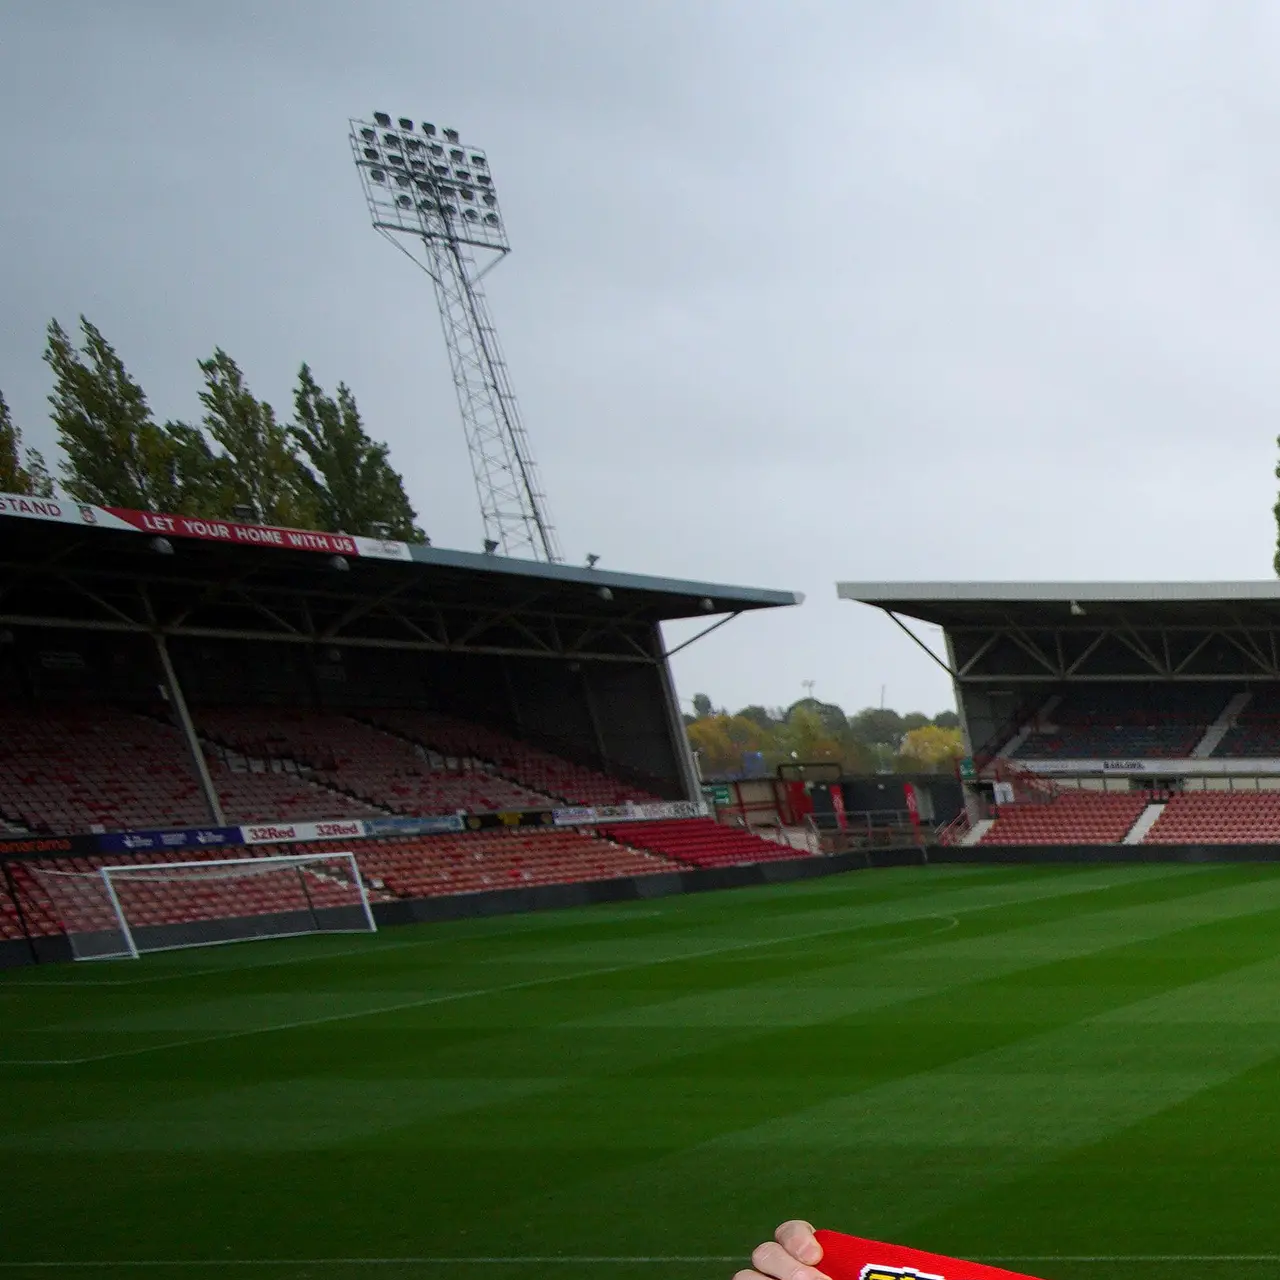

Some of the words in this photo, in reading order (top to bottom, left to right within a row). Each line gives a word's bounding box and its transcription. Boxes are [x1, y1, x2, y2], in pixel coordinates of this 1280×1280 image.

[143, 514, 176, 532] LET
[182, 519, 230, 539] YOUR
[235, 525, 282, 545] HOME
[288, 531, 328, 550] WITH
[331, 535, 354, 553] US
[248, 826, 296, 841] 32Red
[315, 822, 360, 837] 32Red
